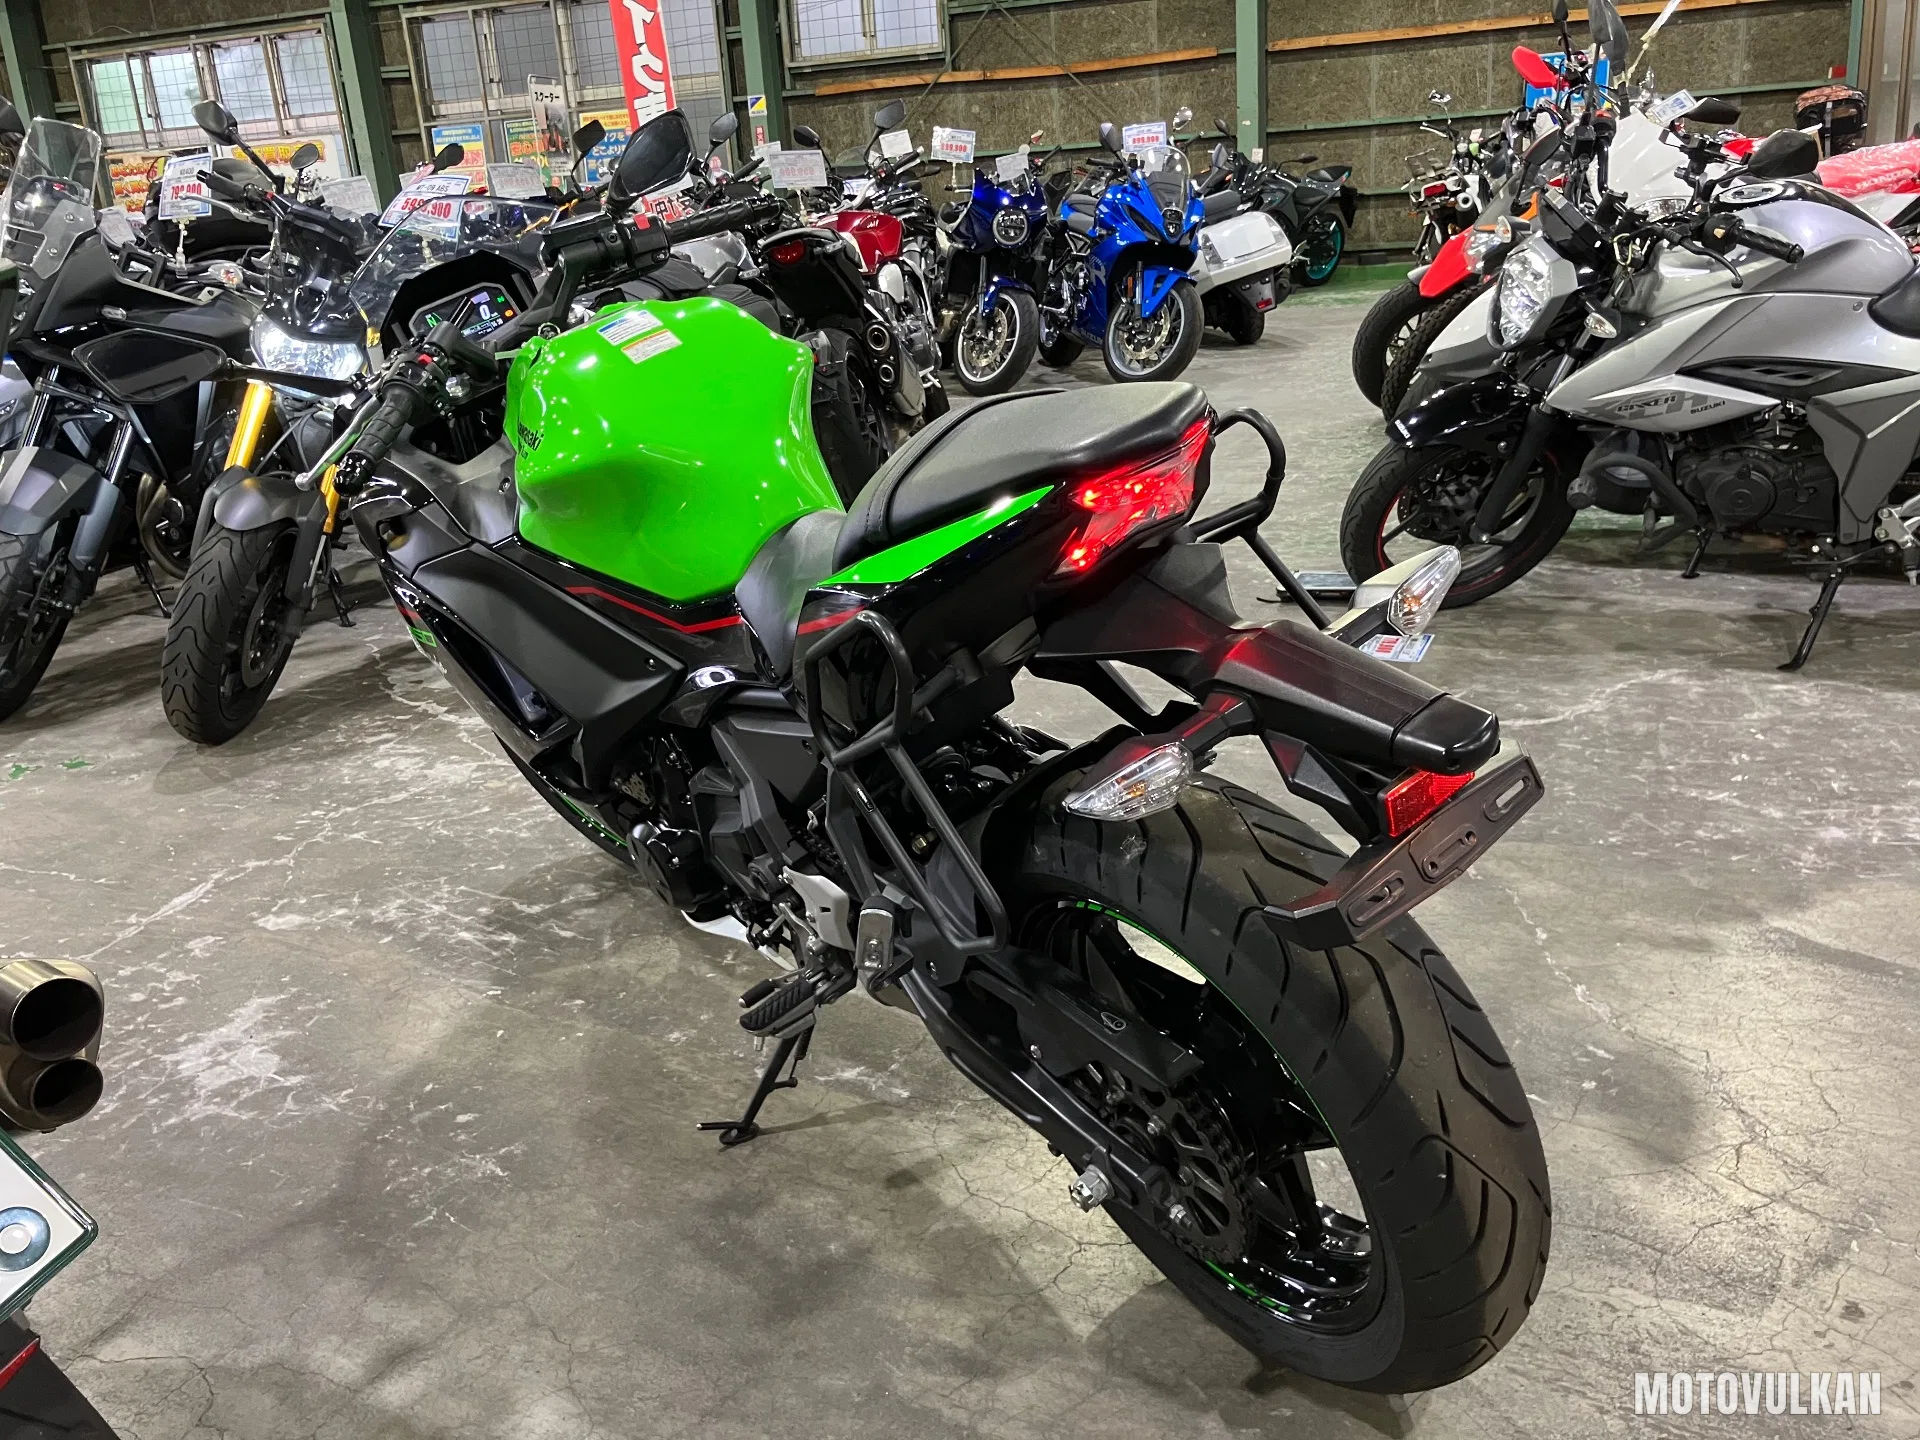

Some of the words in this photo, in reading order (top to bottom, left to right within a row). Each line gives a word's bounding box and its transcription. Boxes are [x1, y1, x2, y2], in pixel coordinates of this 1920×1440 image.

[534, 91, 560, 102] スクーター
[436, 183, 450, 193] ABS
[479, 304, 491, 320] 0
[1690, 400, 1726, 415] SUZUKI
